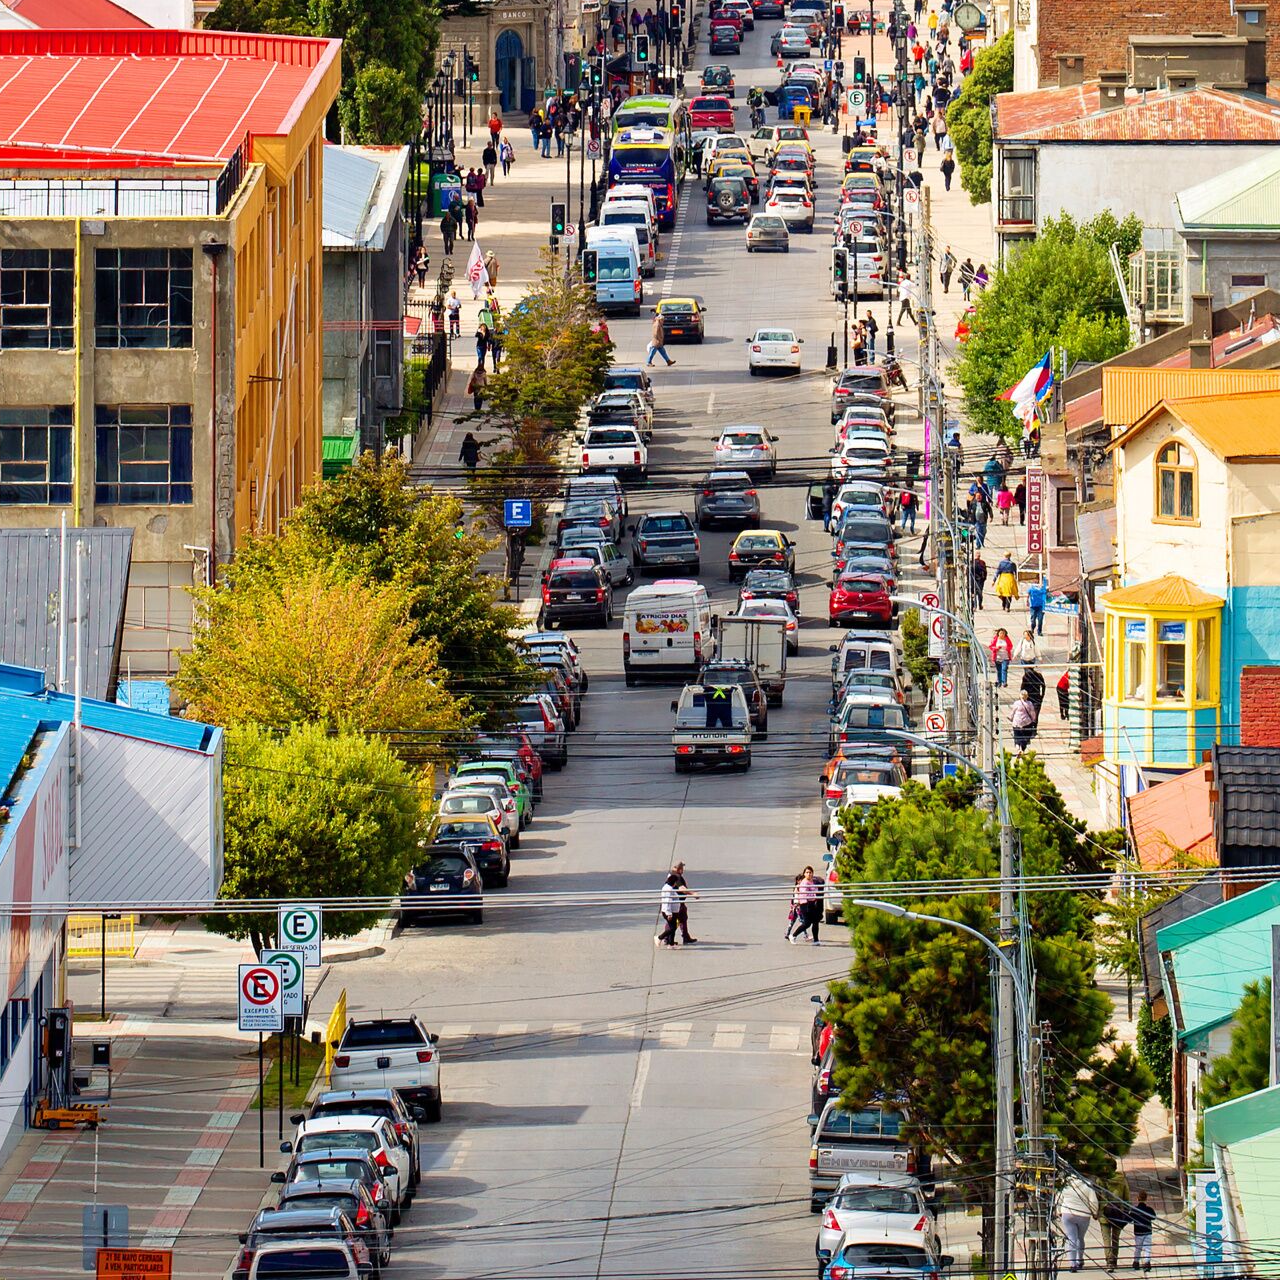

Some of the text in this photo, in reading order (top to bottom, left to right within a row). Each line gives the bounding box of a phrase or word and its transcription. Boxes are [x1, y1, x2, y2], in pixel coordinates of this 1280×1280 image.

[854, 94, 860, 104] E
[512, 503, 523, 519] E
[1029, 476, 1041, 550] MERCURIO
[932, 718, 939, 730] E
[293, 915, 306, 935] E
[253, 976, 268, 998] E
[822, 1157, 904, 1169] CHEVROLET
[122, 1253, 138, 1262] MAYO
[123, 1263, 163, 1272] PARTICULARES
